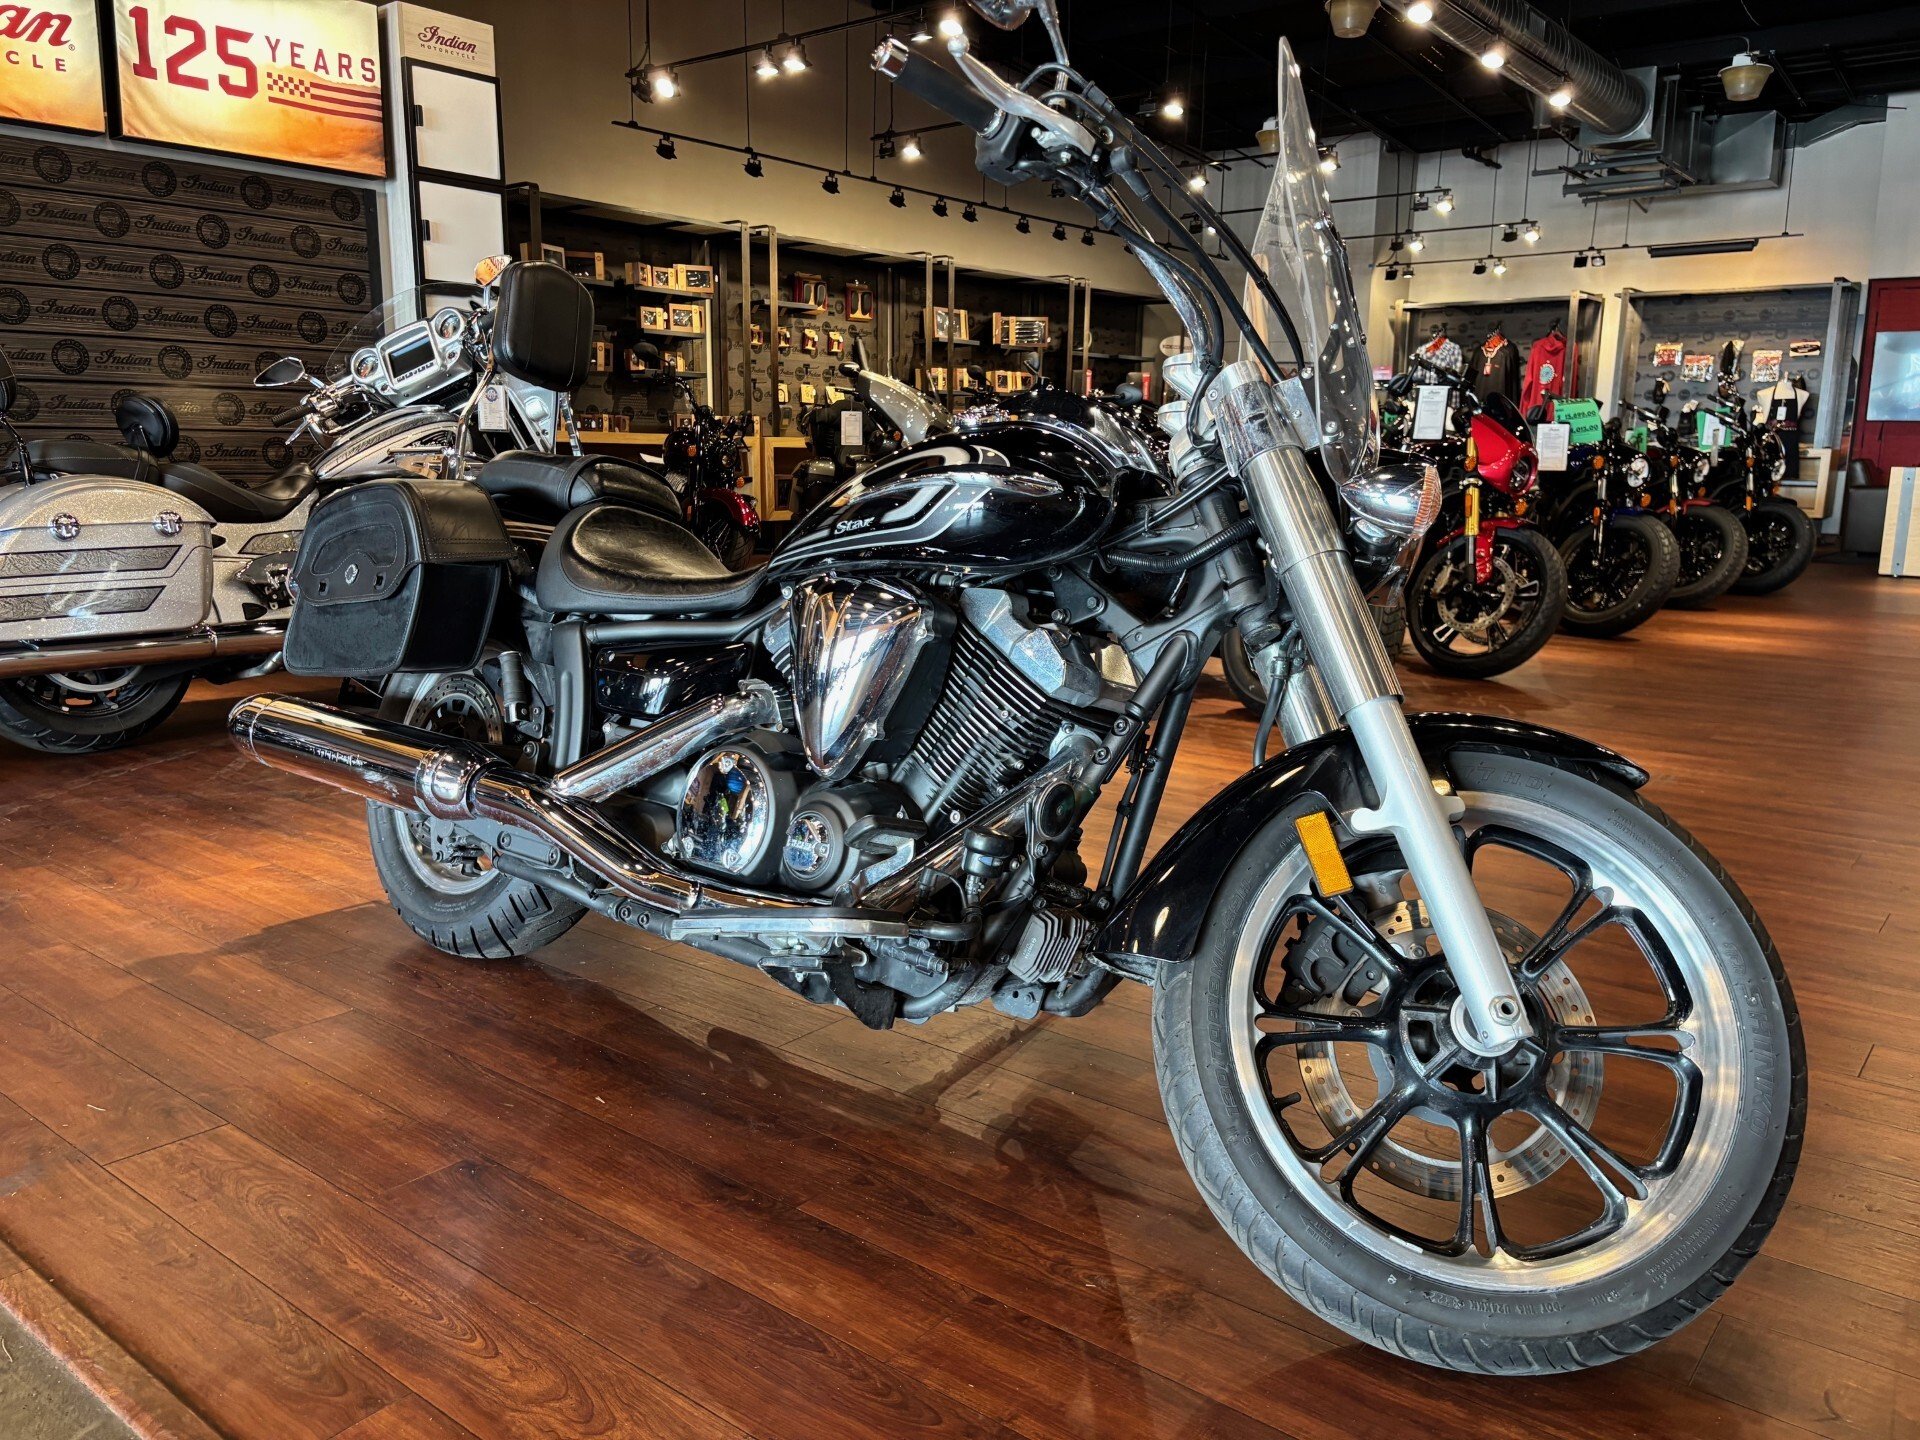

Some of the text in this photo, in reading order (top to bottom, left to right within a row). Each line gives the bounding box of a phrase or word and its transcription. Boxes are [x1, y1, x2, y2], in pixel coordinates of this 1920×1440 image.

[418, 26, 476, 53] Indian
[128, 6, 377, 99] 125 YEARS
[420, 43, 476, 60] MOTORCYCLE
[26, 202, 88, 222] Indian
[134, 214, 191, 234] Indian
[234, 226, 286, 244] Indian
[85, 255, 144, 274] Indian
[188, 265, 242, 283] Indian
[283, 275, 332, 293] Indian
[35, 298, 97, 316] Indian
[143, 306, 199, 323] Indian
[241, 314, 292, 331] Indian
[94, 348, 152, 366] Indian
[197, 354, 250, 371] Indian
[45, 394, 105, 411] Indian
[204, 443, 257, 458] Indian
[834, 517, 875, 534] Star
